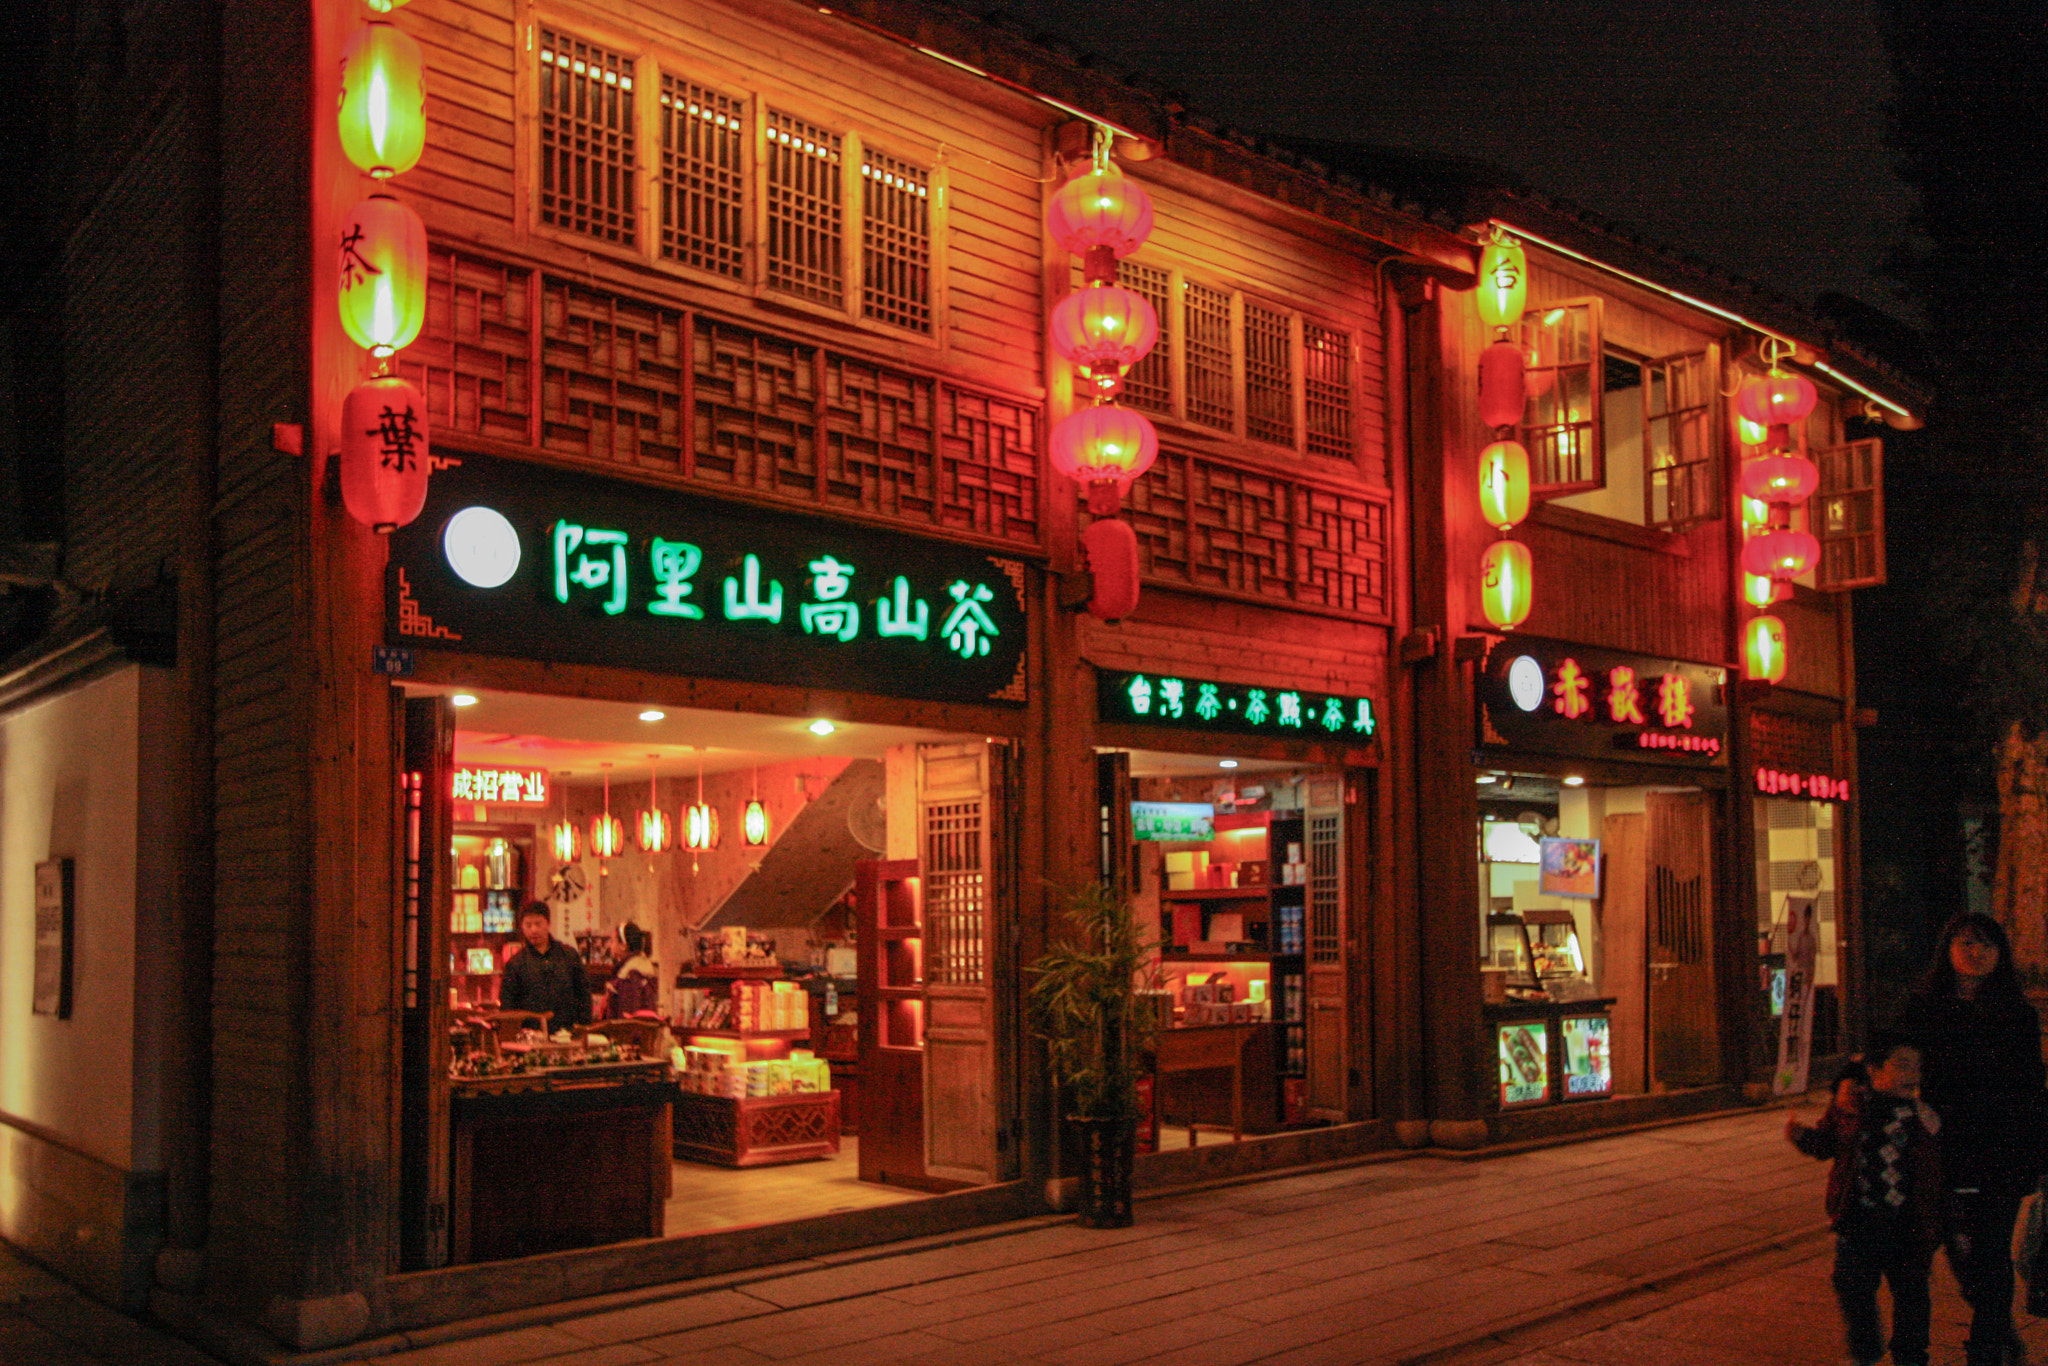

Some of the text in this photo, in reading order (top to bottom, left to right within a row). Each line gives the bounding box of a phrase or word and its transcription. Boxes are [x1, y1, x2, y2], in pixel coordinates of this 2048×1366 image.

[365, 405, 424, 473] 葉
[553, 518, 1000, 659] 阿里山高山茶
